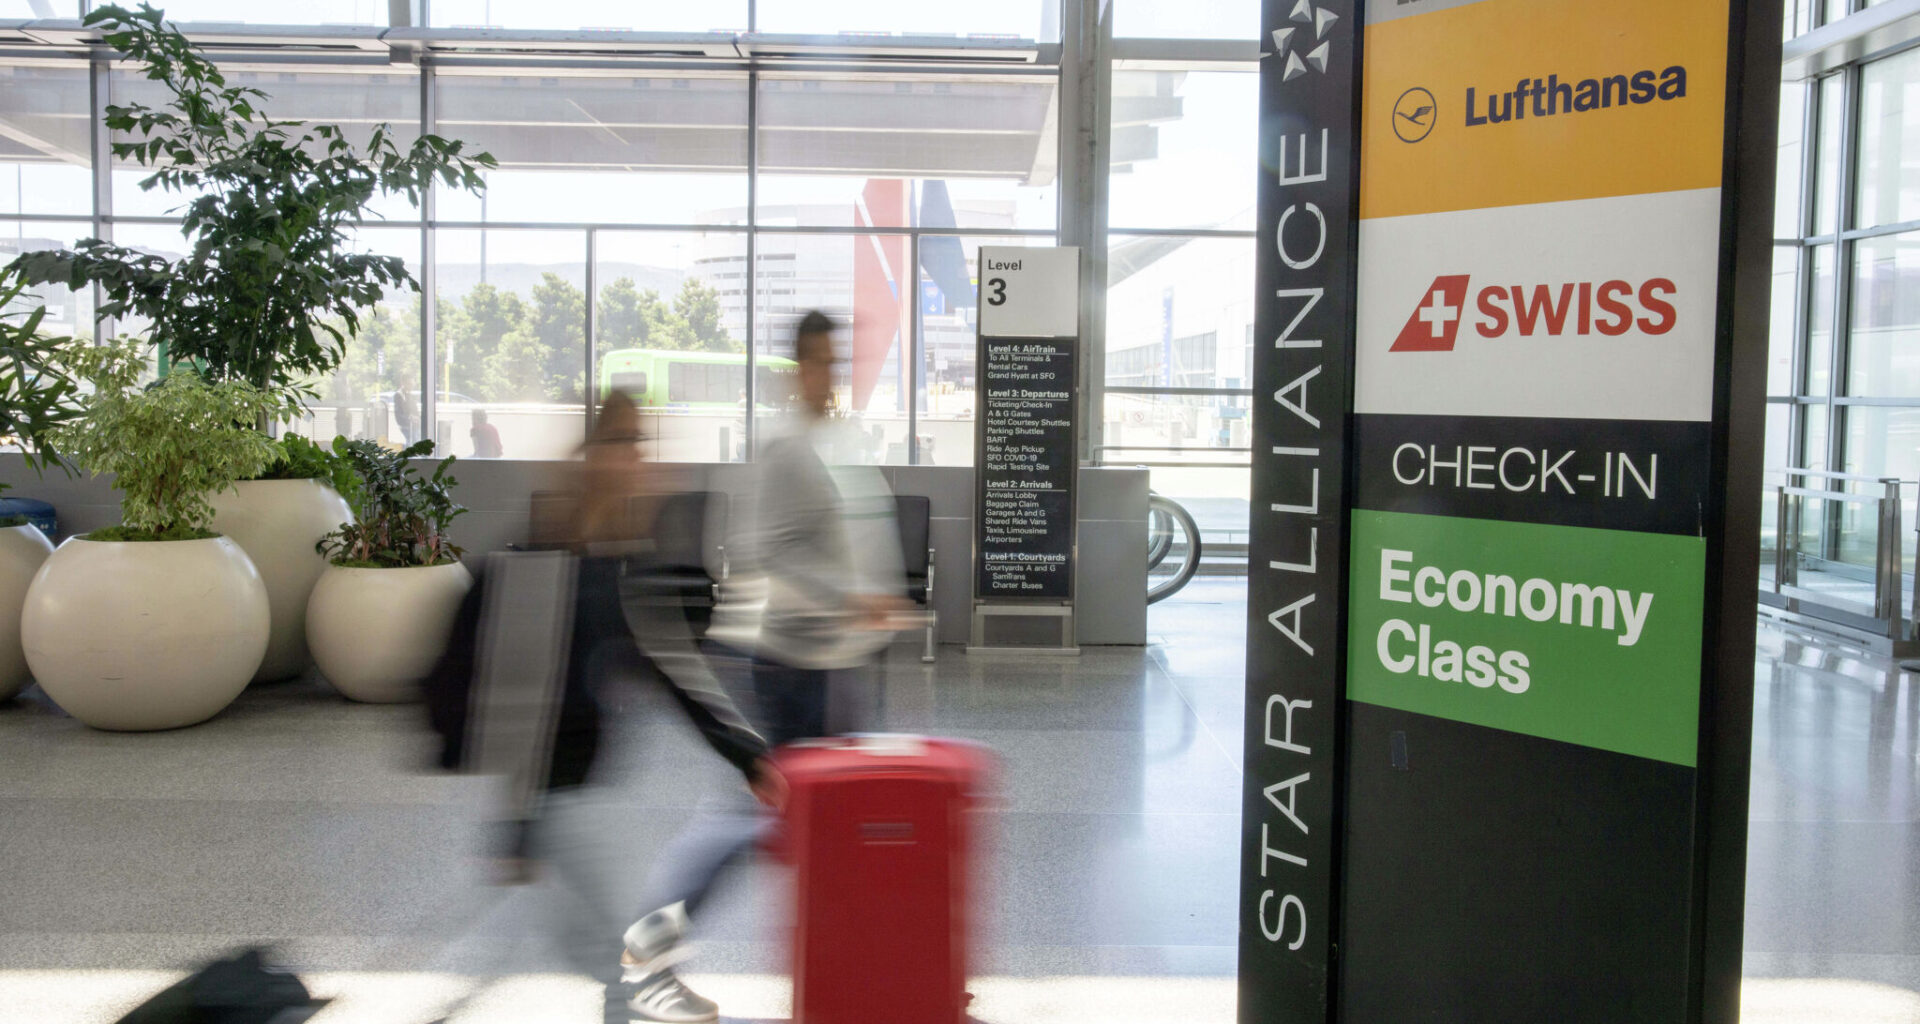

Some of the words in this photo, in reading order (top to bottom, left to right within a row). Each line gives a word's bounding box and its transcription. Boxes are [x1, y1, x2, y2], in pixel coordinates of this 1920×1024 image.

[1465, 65, 1687, 127] Lufthansa
[988, 259, 1022, 271] Level
[987, 278, 1007, 306] 3
[1475, 277, 1678, 339] SWISS
[988, 344, 1011, 353] Level
[1012, 345, 1020, 353] 4:
[1023, 345, 1056, 353] AirTrain
[1011, 372, 1030, 380] Hyatt
[988, 389, 1010, 397] Level
[1012, 389, 1019, 397] 3:
[1021, 389, 1069, 399] Departures
[1268, 128, 1328, 656] ALLIANCE
[988, 401, 1052, 409] Ticketing/Check-In
[987, 418, 1006, 426] Hotel
[1007, 419, 1039, 427] Courtesy
[987, 427, 1013, 436] Parking
[1004, 445, 1020, 453] App
[1021, 445, 1045, 454] Pickup
[1004, 454, 1037, 462] COVID-19
[987, 463, 1007, 471] Rapid
[1010, 464, 1034, 472] Testing
[1392, 442, 1658, 500] CHECK-IN
[986, 480, 1009, 488] Level
[1010, 480, 1018, 488] 2:
[1020, 480, 1053, 489] Arrivals
[986, 491, 1013, 499] Arrivals
[986, 500, 1017, 508] Baggage
[985, 509, 1015, 517] Garages
[1006, 527, 1047, 535] Limousines
[985, 536, 1022, 544] Airporters
[985, 552, 1007, 560] Level
[1018, 553, 1066, 562] Courtyards
[985, 564, 1024, 572] Courtyards
[992, 581, 1019, 589] Charter
[1378, 548, 1654, 647] Economy
[1376, 619, 1531, 694] Class
[1259, 694, 1313, 950] STAR
